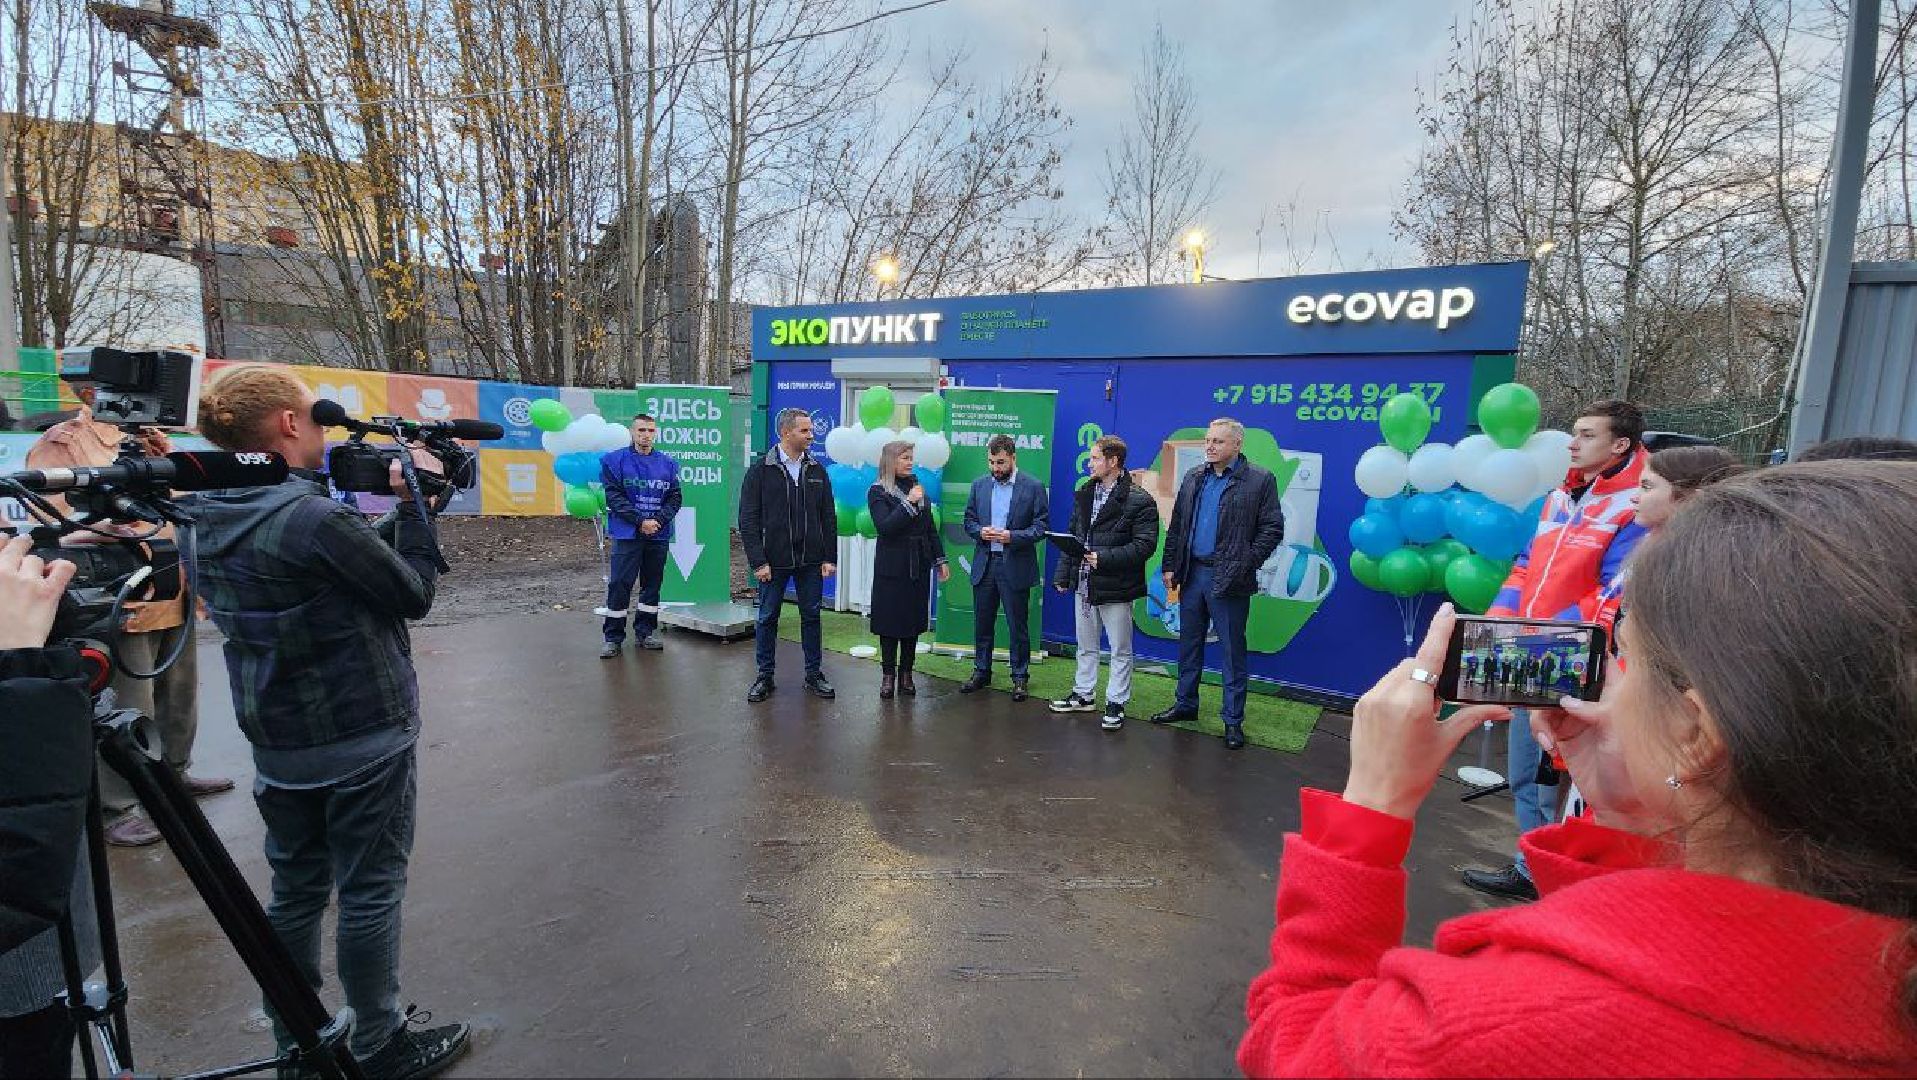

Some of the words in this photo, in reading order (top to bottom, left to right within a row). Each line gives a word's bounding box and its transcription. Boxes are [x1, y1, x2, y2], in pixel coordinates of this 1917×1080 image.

[1288, 287, 1475, 329] ecovap
[771, 313, 942, 345] ЭКОПУНКТ
[1213, 385, 1244, 404] +7
[1251, 384, 1293, 404] 915
[1300, 383, 1352, 403] 434
[646, 397, 722, 422] ЗДЕСЬ
